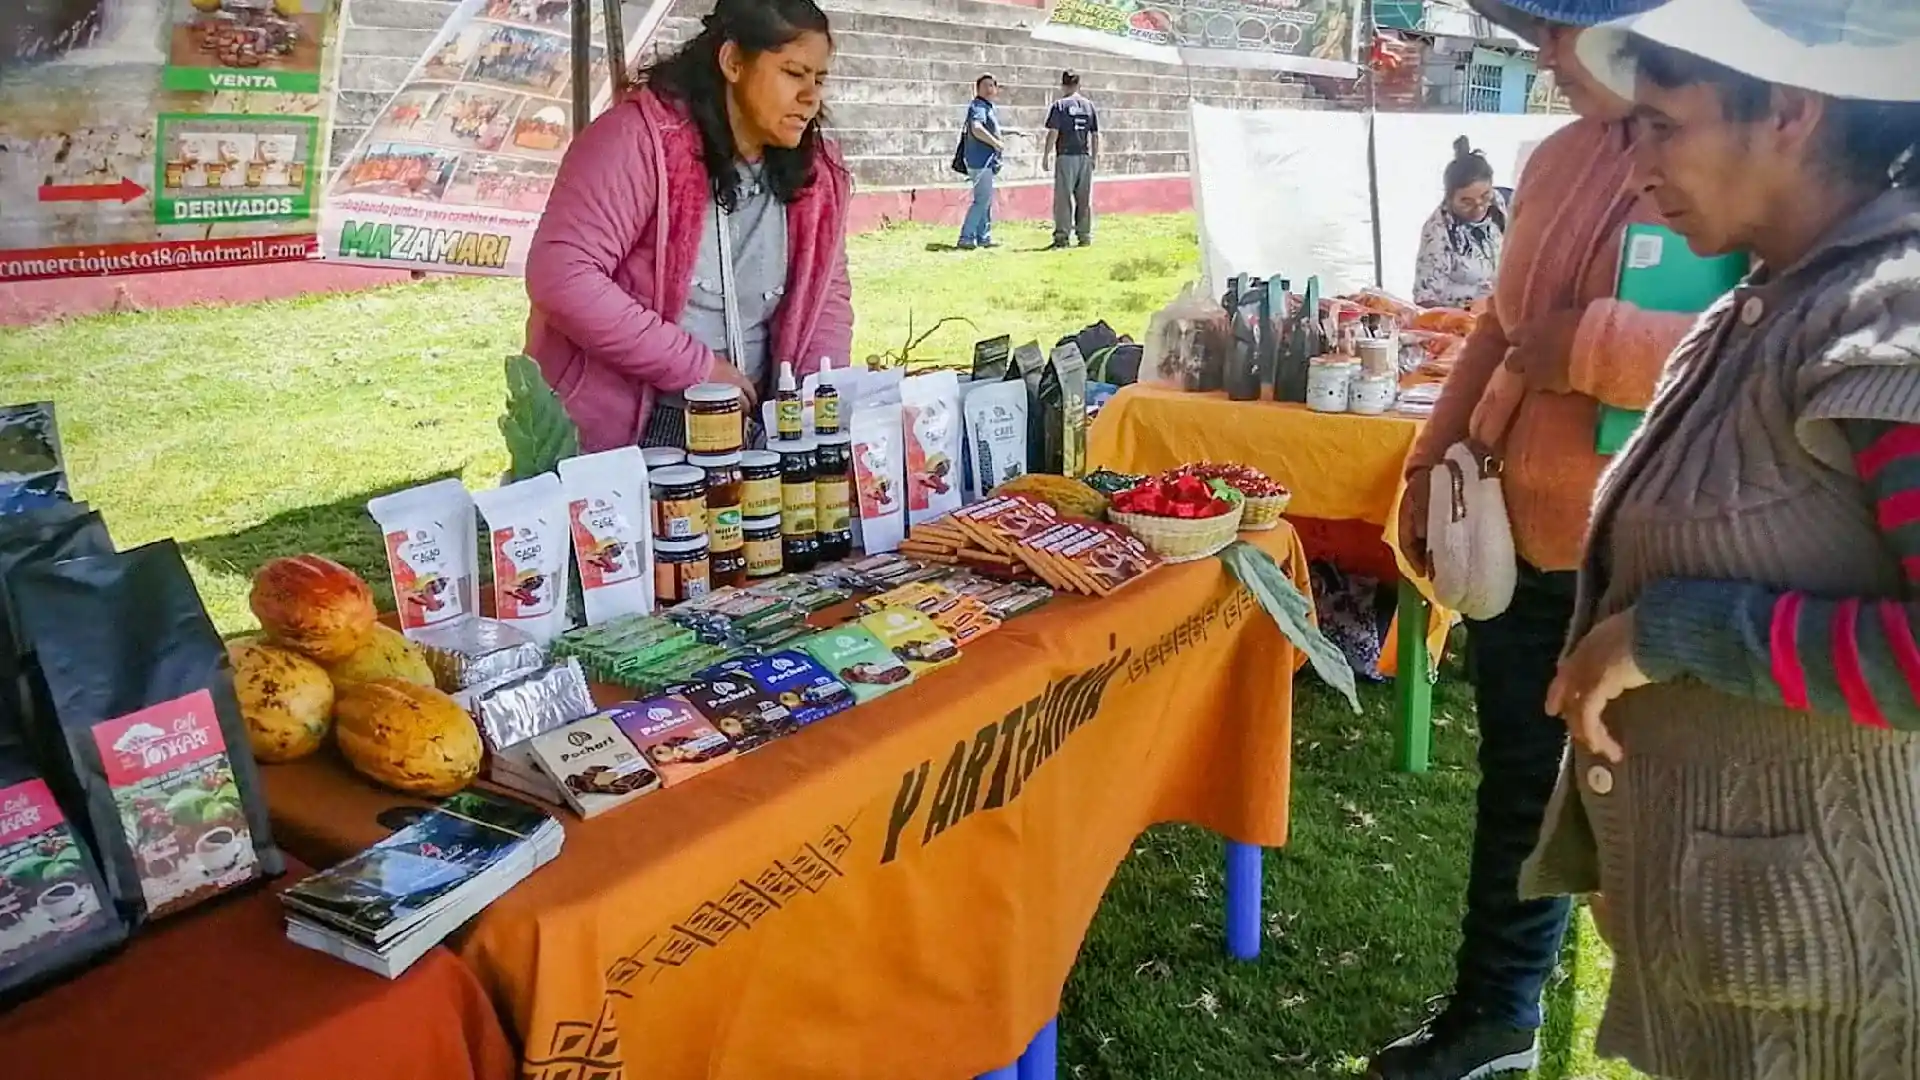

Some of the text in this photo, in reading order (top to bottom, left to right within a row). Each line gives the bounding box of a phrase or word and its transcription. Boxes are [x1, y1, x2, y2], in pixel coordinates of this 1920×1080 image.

[208, 73, 278, 88] VENTA
[174, 197, 293, 220] DERIVADOS
[339, 219, 512, 269] MAZAMARI
[0, 240, 306, 277] comerciojusto18@hotmail.com
[411, 547, 441, 562] CACAO
[514, 544, 542, 558] CACAO
[880, 759, 931, 865] Y
